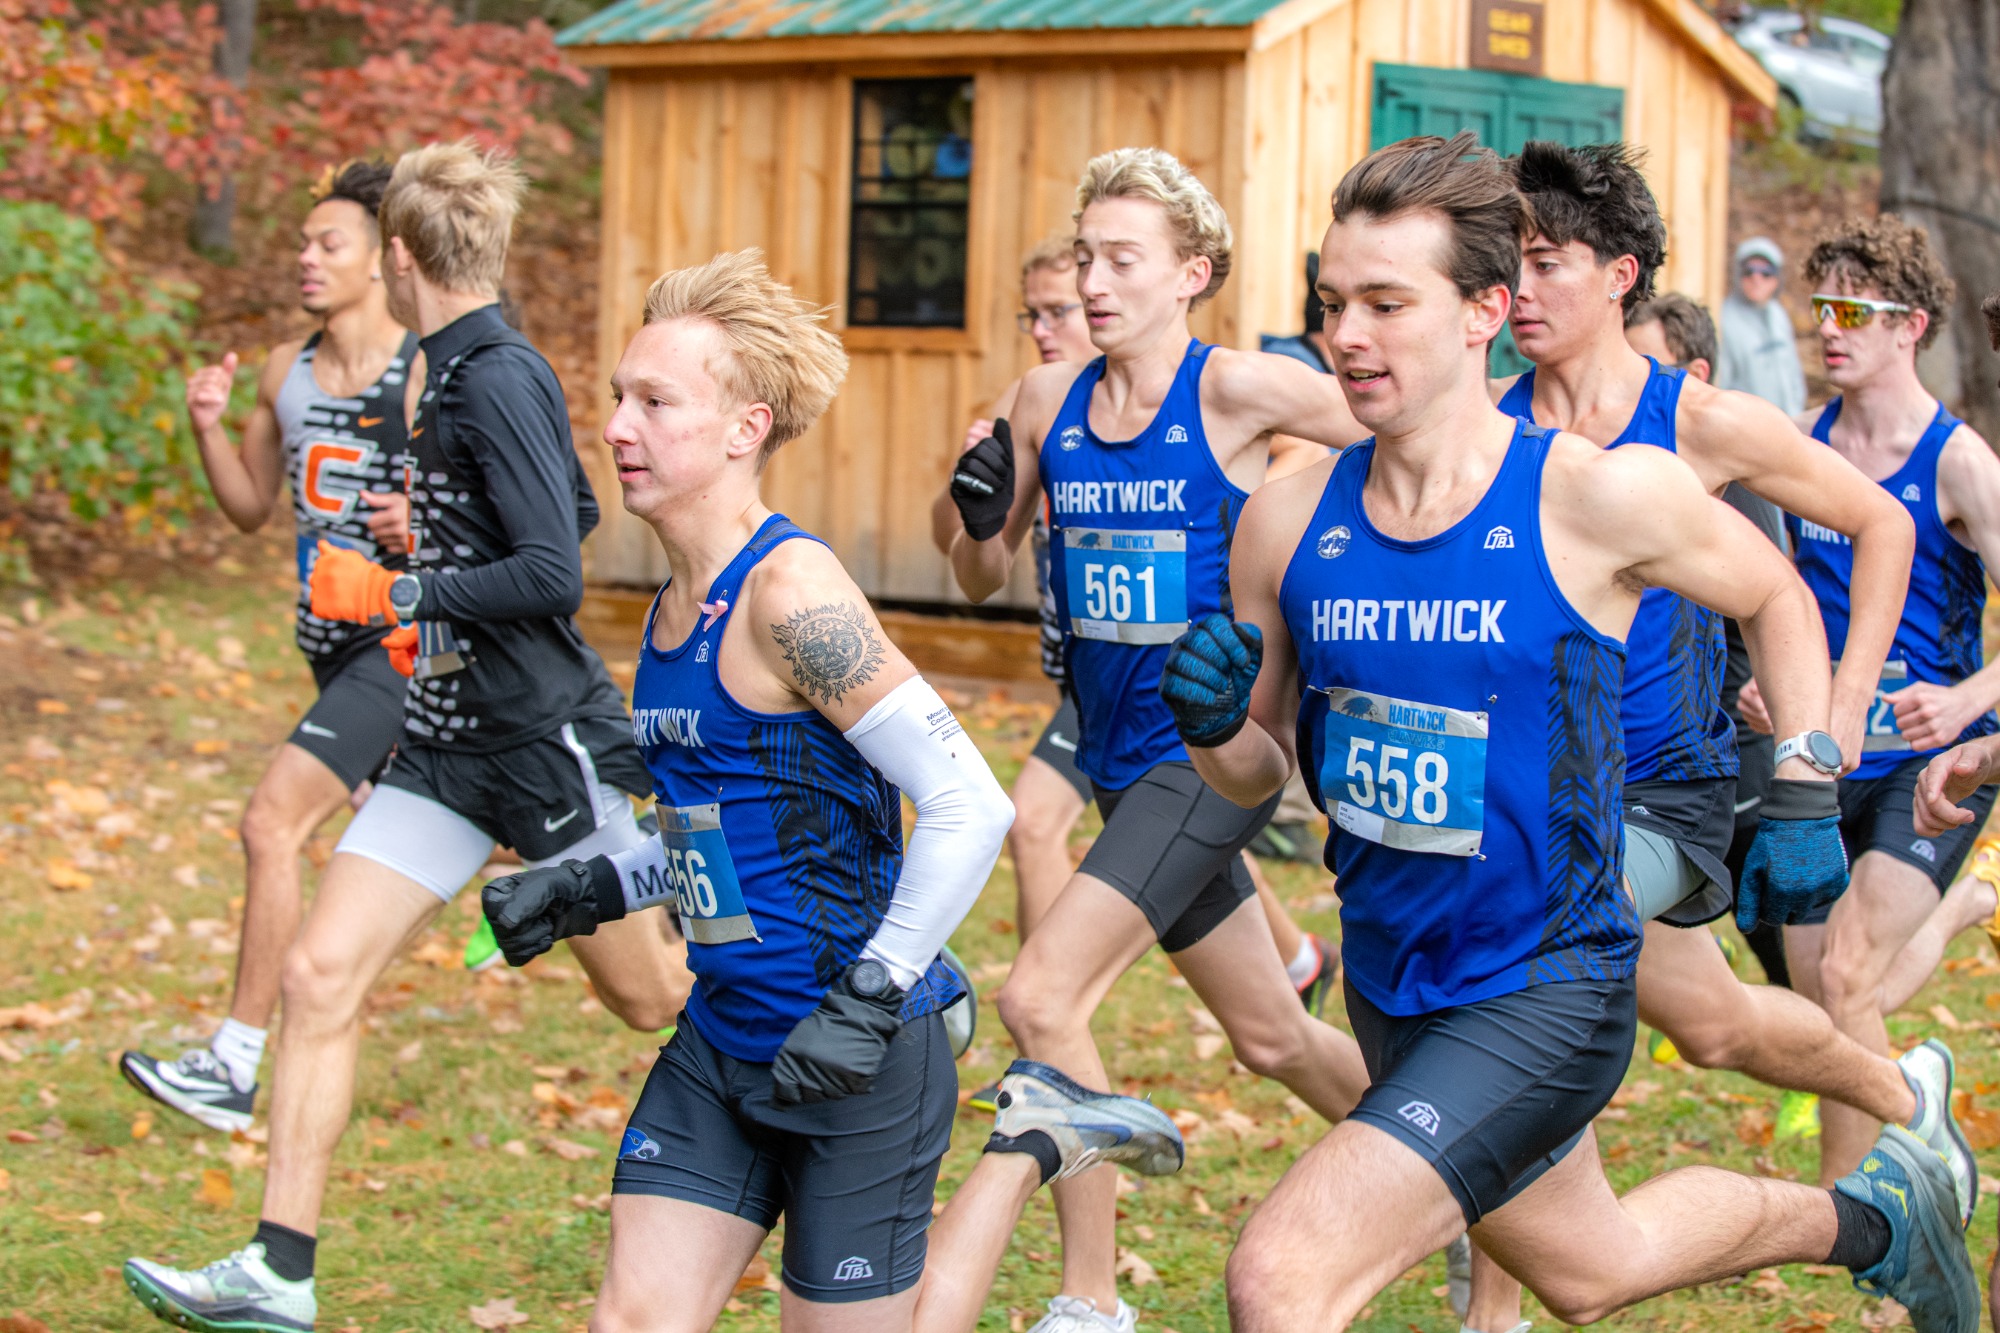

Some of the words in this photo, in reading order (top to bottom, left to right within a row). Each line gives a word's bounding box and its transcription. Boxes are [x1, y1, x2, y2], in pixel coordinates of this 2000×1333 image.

[1053, 480, 1187, 513] HARTWICK
[1111, 534, 1155, 550] HARTWICK
[1085, 563, 1156, 622] 561
[1312, 598, 1507, 643] HARTWICK
[633, 708, 705, 748] ARTWICK
[1388, 703, 1446, 732] HARTWICK
[1387, 728, 1445, 750] HAWKS
[1346, 736, 1449, 824] 558
